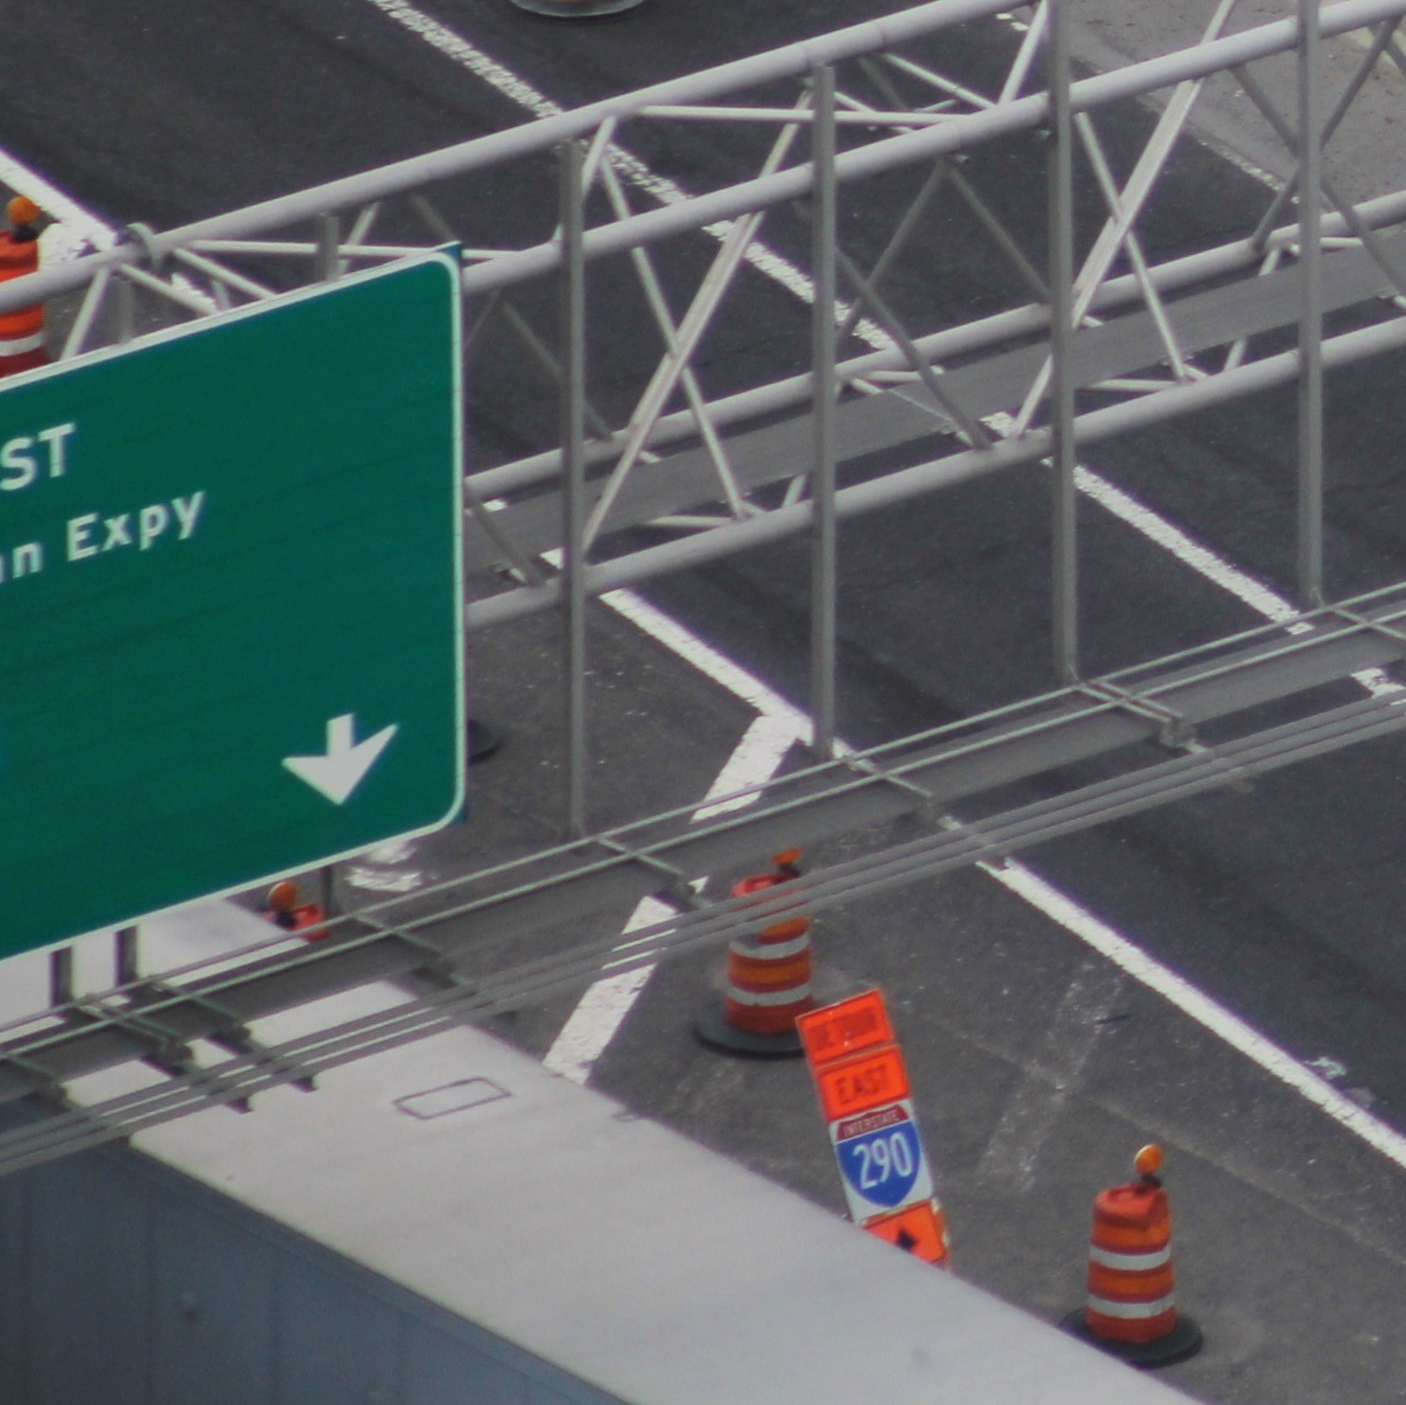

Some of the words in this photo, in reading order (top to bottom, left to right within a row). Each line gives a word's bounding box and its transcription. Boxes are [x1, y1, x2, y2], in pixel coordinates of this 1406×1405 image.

[66, 490, 206, 562] Expy
[836, 1063, 890, 1105] EAST
[843, 1108, 898, 1137] INTERSTATE
[852, 1131, 913, 1190] 290
